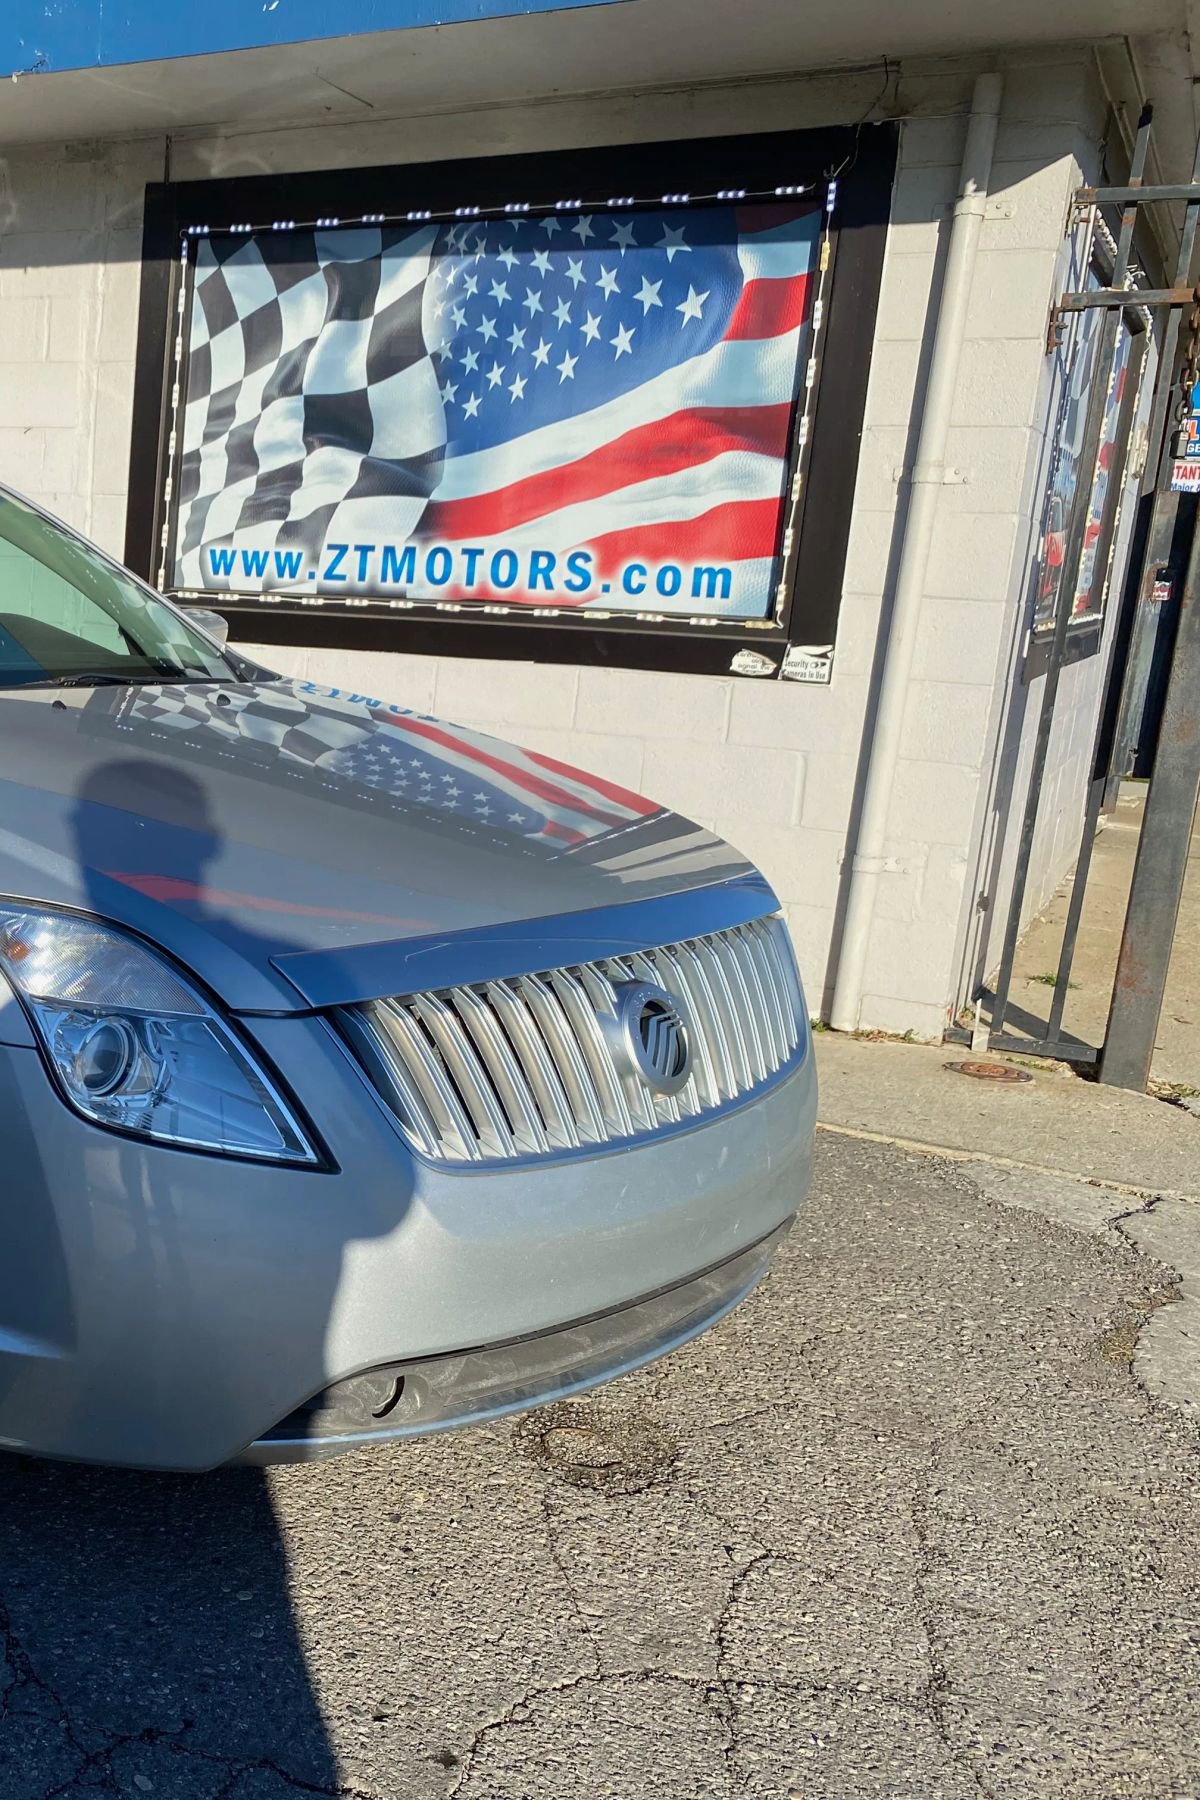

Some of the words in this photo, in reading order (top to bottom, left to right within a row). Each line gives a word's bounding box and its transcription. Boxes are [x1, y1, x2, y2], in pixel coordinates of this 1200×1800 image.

[209, 544, 732, 599] www.ZTMOTORS.com
[785, 659, 809, 670] Security
[816, 671, 826, 680] Use
